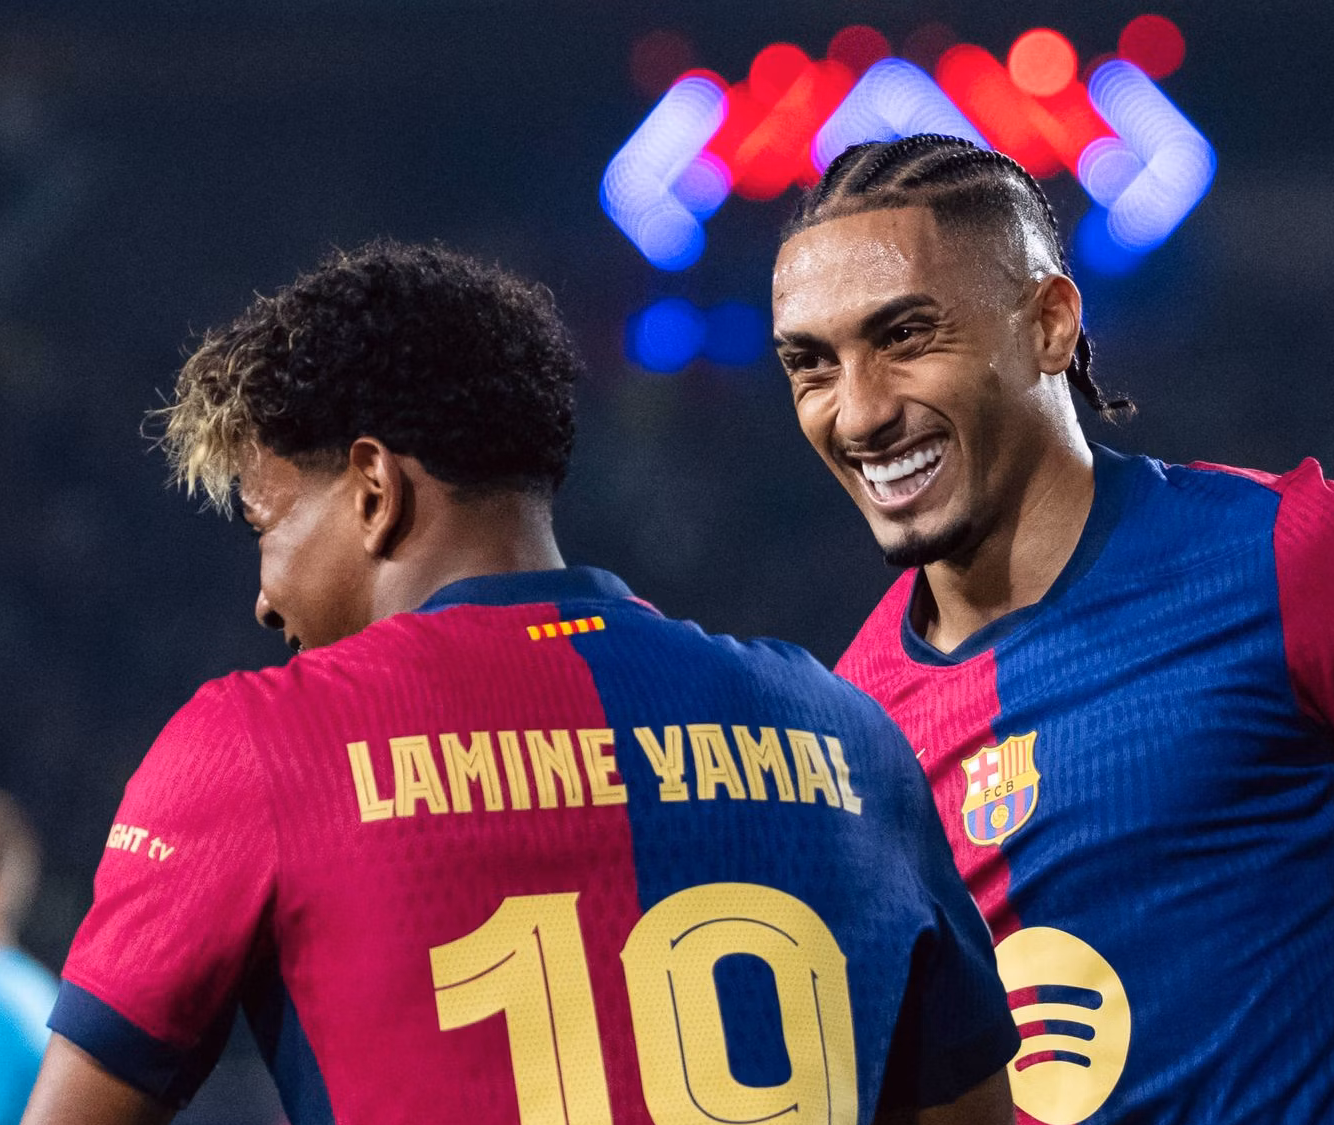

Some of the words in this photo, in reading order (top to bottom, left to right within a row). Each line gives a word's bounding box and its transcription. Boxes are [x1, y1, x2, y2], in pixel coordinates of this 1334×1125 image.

[346, 727, 628, 823] LAMINE
[633, 723, 863, 816] YAMAL
[147, 836, 175, 862] tv
